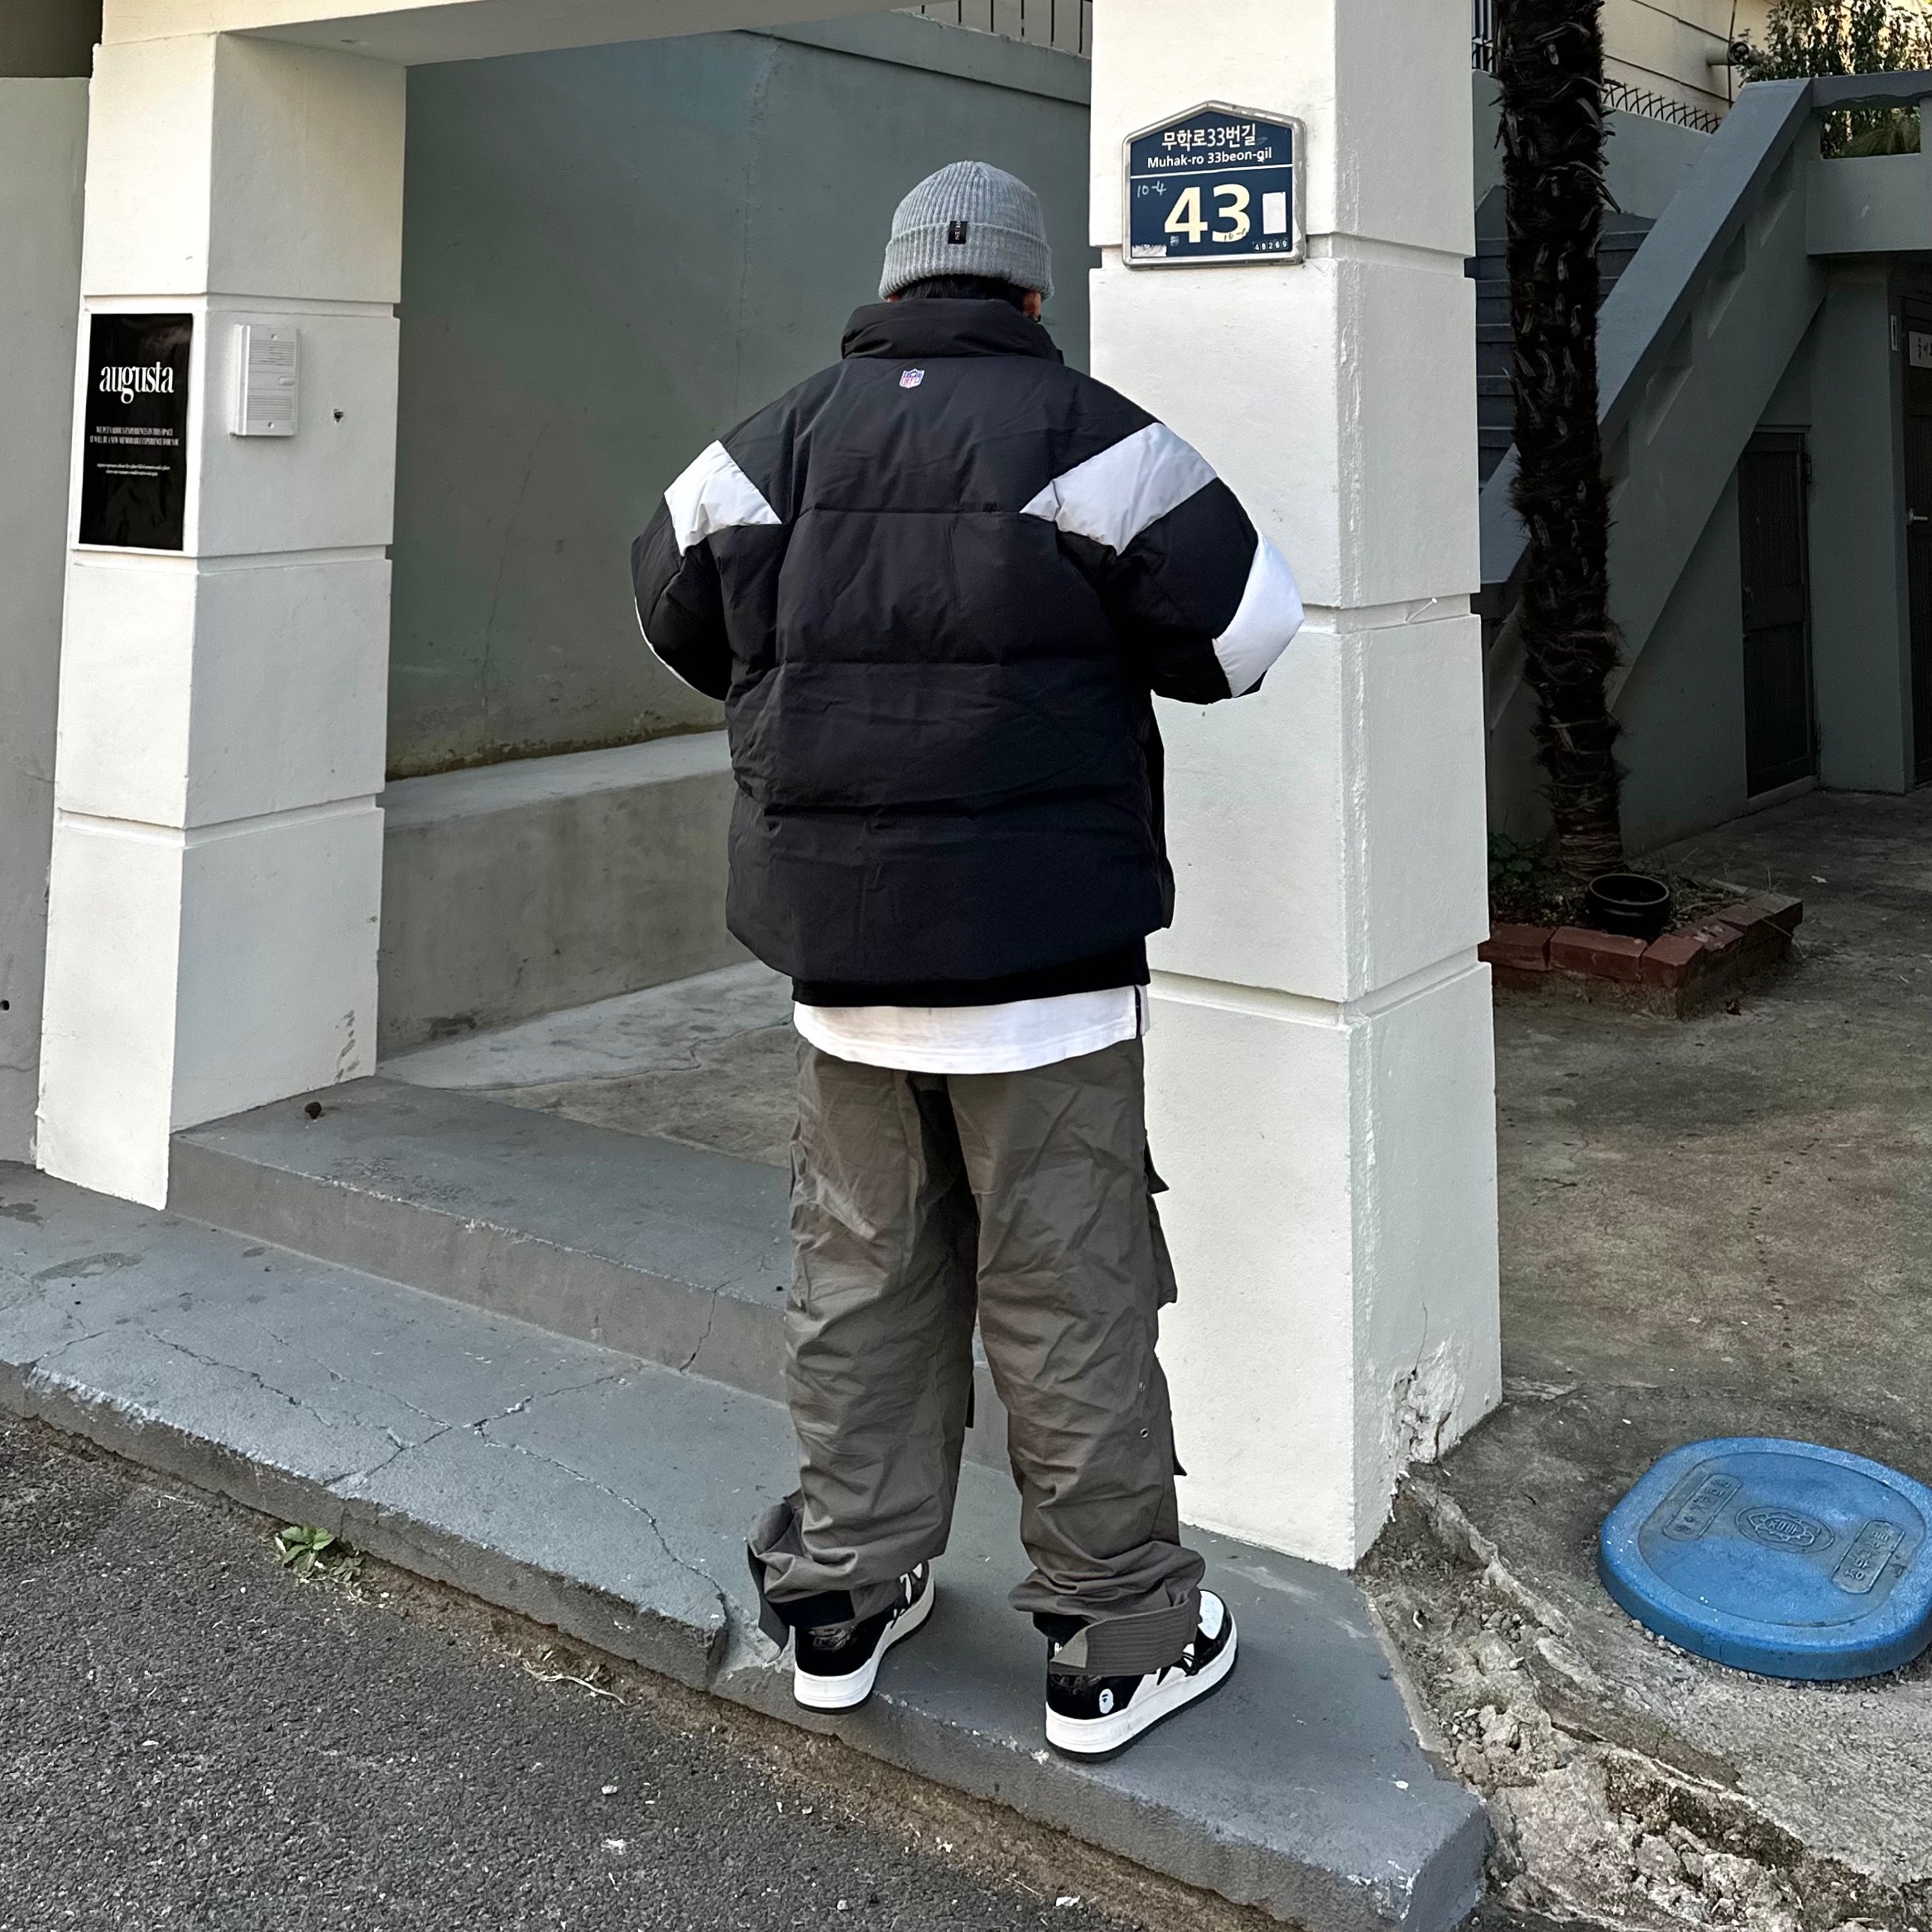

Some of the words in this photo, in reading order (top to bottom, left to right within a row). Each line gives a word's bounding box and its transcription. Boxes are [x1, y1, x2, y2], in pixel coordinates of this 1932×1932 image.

[1161, 123, 1256, 151] 무학로33번길
[1147, 154, 1204, 169] Muhak-ro
[1208, 147, 1272, 162] 33beon-gil
[1164, 183, 1251, 243] 43
[99, 361, 175, 404] augusta
